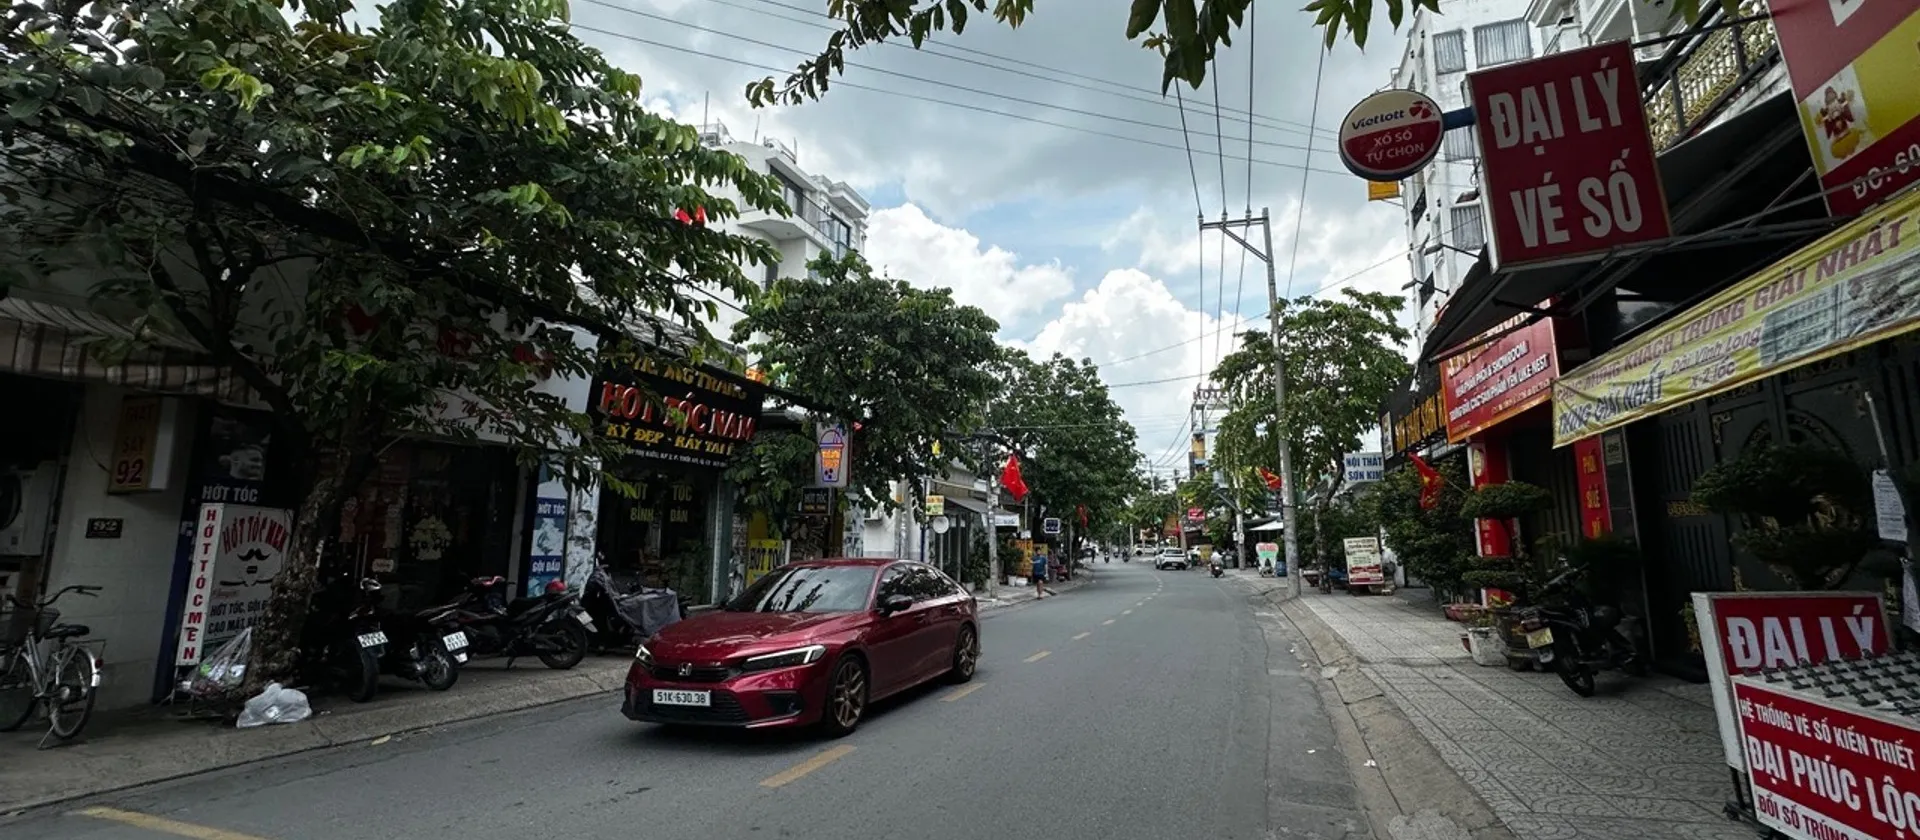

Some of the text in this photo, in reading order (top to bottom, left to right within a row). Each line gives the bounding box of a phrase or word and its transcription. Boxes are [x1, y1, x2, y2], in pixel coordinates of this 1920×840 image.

[1351, 110, 1406, 130] Vietlott
[1488, 56, 1623, 156] ĐẠI LÝ
[1386, 143, 1425, 158] CHỌN
[1509, 148, 1644, 248] VÉ SỐ
[1624, 334, 1675, 371] KHÁCH
[1679, 298, 1746, 343] TRÚNG
[1753, 266, 1808, 311] GIẢI
[1815, 217, 1909, 284] NHẤT
[1623, 360, 1666, 412] NHẤT
[1726, 328, 1761, 352] Long
[633, 427, 665, 447] ĐẸP
[709, 408, 757, 441] NAM
[116, 458, 143, 485] 92
[1348, 470, 1365, 481] SƠN
[233, 485, 260, 503] TÓC
[657, 691, 707, 704] 51K-630.38
[1739, 697, 1916, 771] HỆ THỐNG VÉ SỐ KIẾN THIẾT
[1747, 735, 1788, 786] ĐẠI
[1788, 749, 1861, 812] PHÚC
[1782, 802, 1801, 830] SỐ
